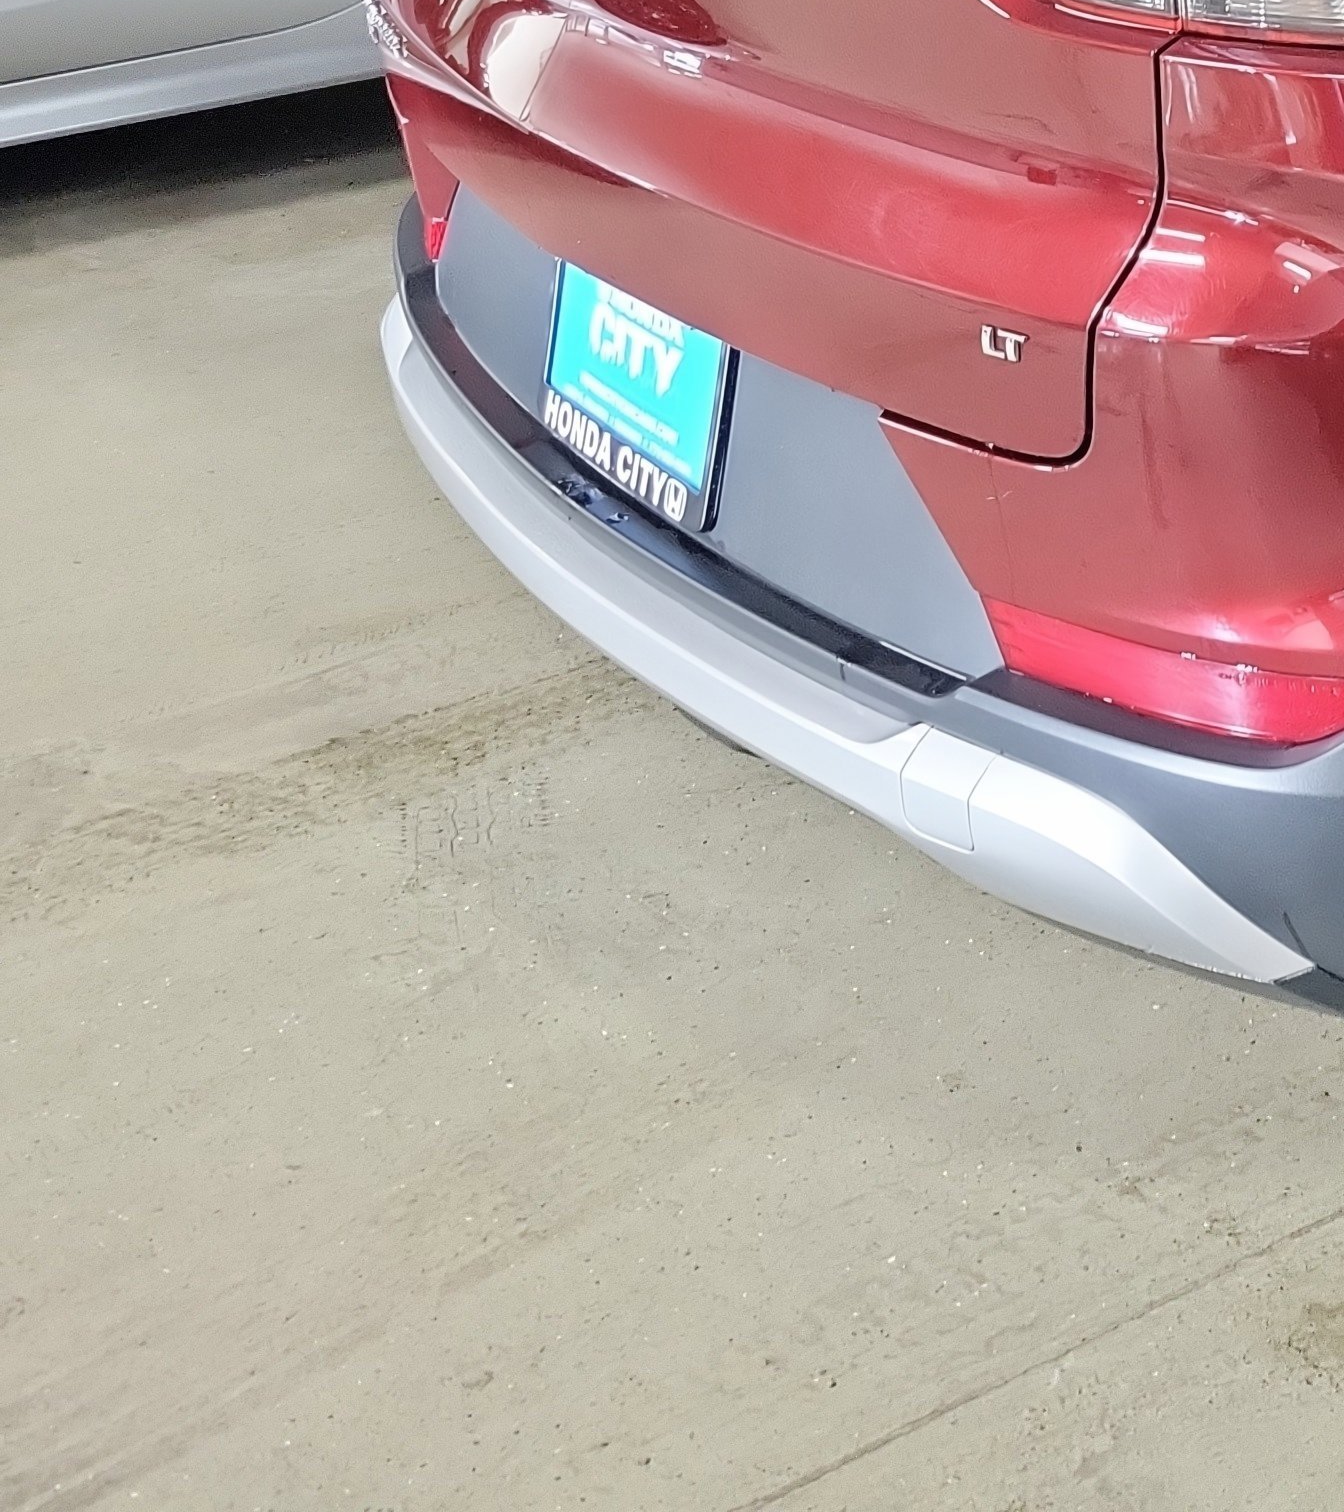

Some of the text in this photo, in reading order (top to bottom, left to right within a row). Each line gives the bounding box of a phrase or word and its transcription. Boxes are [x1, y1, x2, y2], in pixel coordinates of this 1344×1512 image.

[588, 302, 686, 398] CITY
[981, 324, 1027, 362] LT
[544, 389, 611, 471] HONDA
[616, 445, 668, 507] CITY
